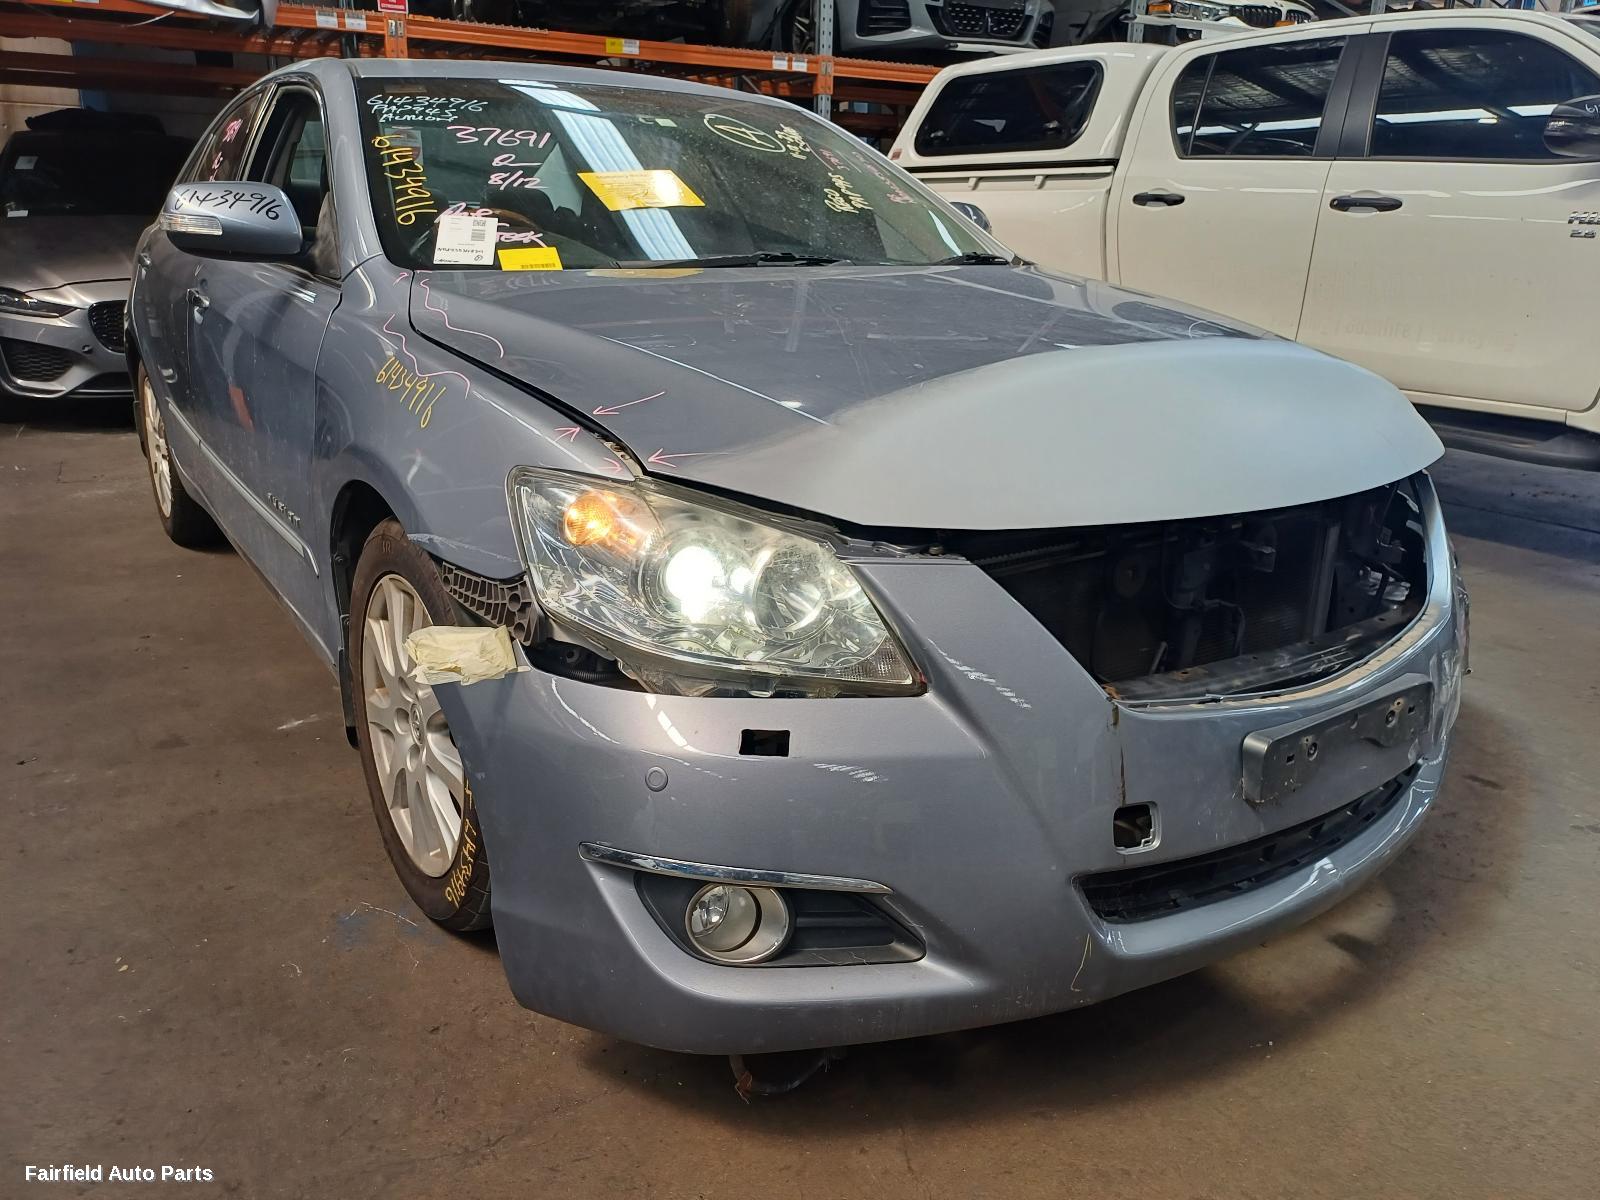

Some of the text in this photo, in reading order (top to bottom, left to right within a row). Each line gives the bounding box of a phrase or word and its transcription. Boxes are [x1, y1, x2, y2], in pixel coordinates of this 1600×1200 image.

[366, 94, 489, 112] 61434916
[446, 125, 552, 149] 37691
[371, 135, 438, 226] 61434916
[375, 356, 446, 429] 61434916
